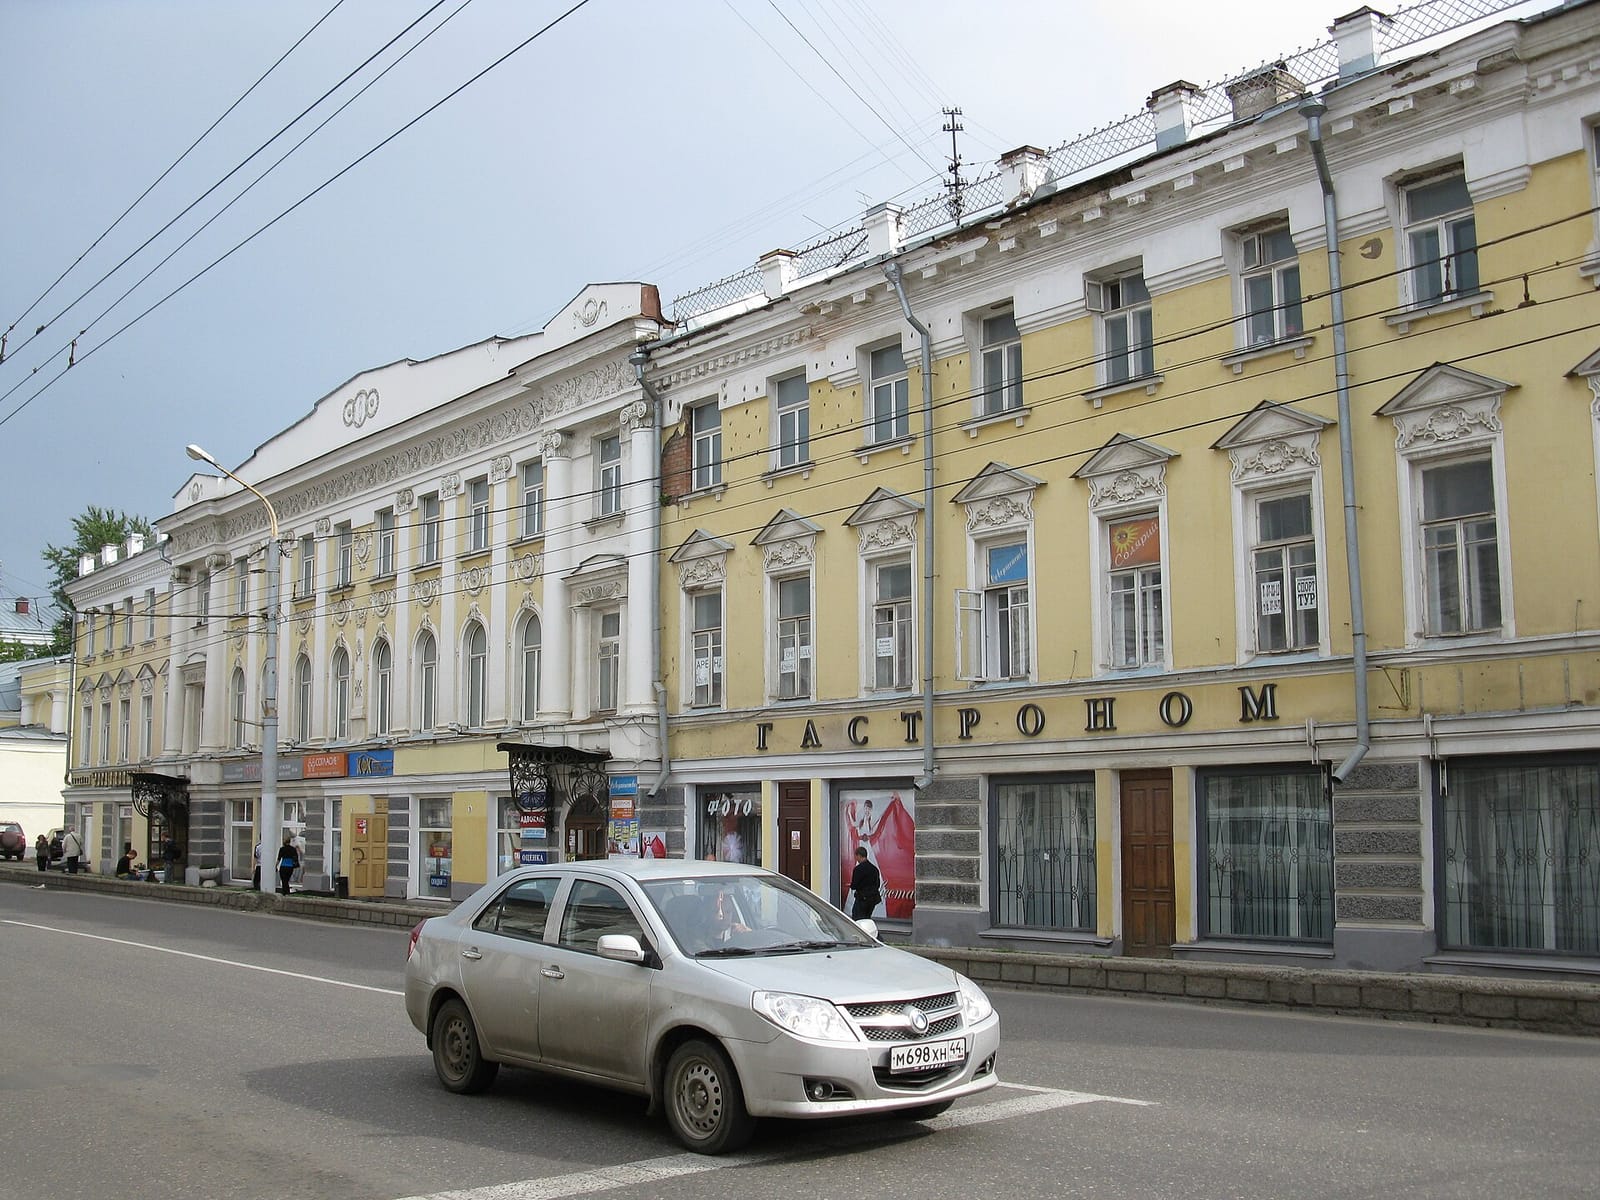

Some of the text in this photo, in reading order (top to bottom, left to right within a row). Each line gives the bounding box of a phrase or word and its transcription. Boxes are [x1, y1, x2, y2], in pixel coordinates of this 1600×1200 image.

[1115, 520, 1159, 567] Солярий
[1297, 581, 1315, 593] СПОРТ
[1297, 593, 1316, 607] ТУР
[756, 683, 1280, 750] ГАСТРОНОМ
[707, 798, 752, 817] ФОТО
[521, 853, 544, 862] ОЦЕНКА
[949, 1041, 961, 1055] 44
